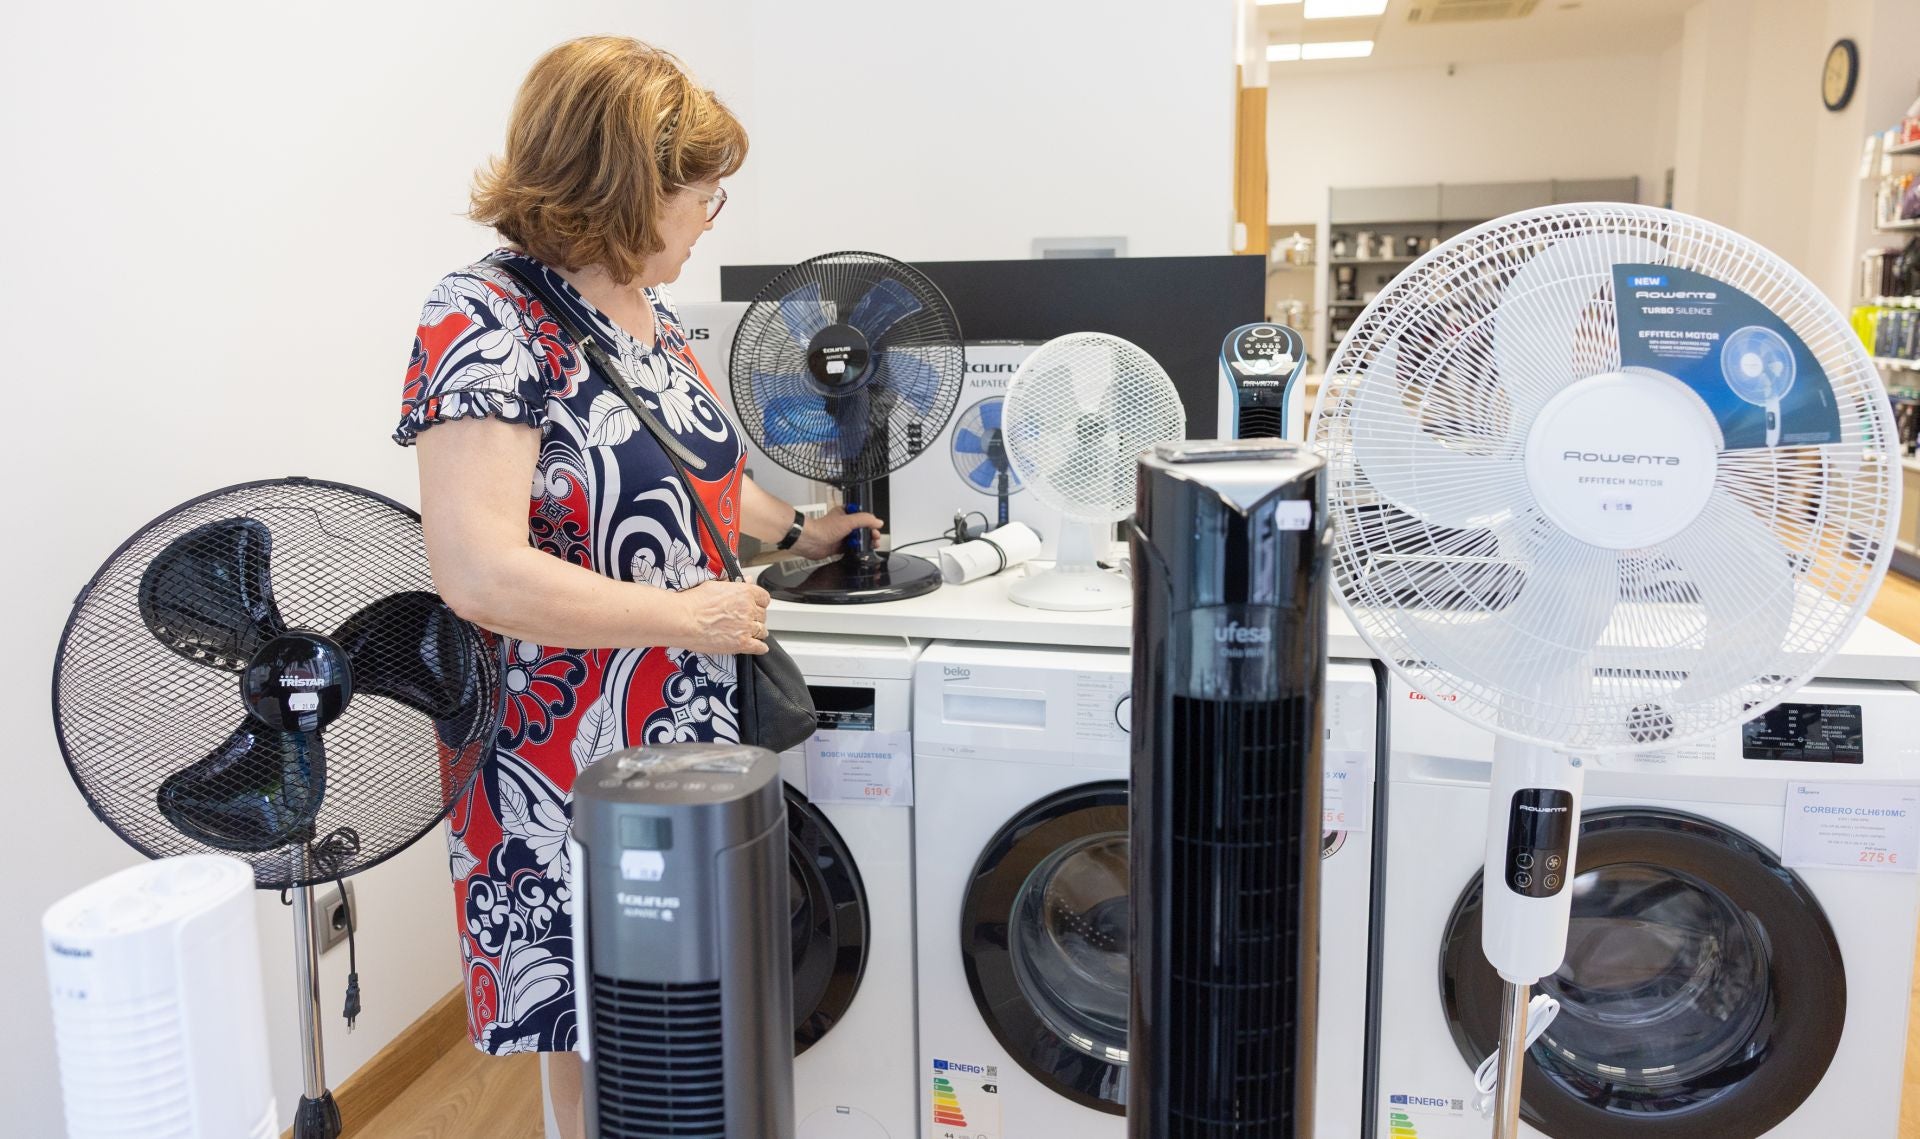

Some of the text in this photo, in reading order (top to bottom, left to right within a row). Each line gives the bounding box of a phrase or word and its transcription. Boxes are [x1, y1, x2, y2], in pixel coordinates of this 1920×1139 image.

[1634, 277, 1660, 286] NEW
[1641, 306, 1712, 316] TURBO SILENCE
[1638, 330, 1719, 341] EFFITECH MOTOR
[964, 362, 1020, 373] tauru
[1579, 476, 1664, 487] EFFITECH MOTOR
[1215, 621, 1271, 642] ufesa
[943, 666, 971, 677] beko
[864, 787, 892, 797] 619 €
[1803, 805, 1907, 818] CORBERO CLH610MC
[1859, 851, 1897, 864] 275 €
[616, 892, 681, 909] taurus
[949, 1063, 980, 1073] ENERG
[1408, 1095, 1445, 1107] ENERG
